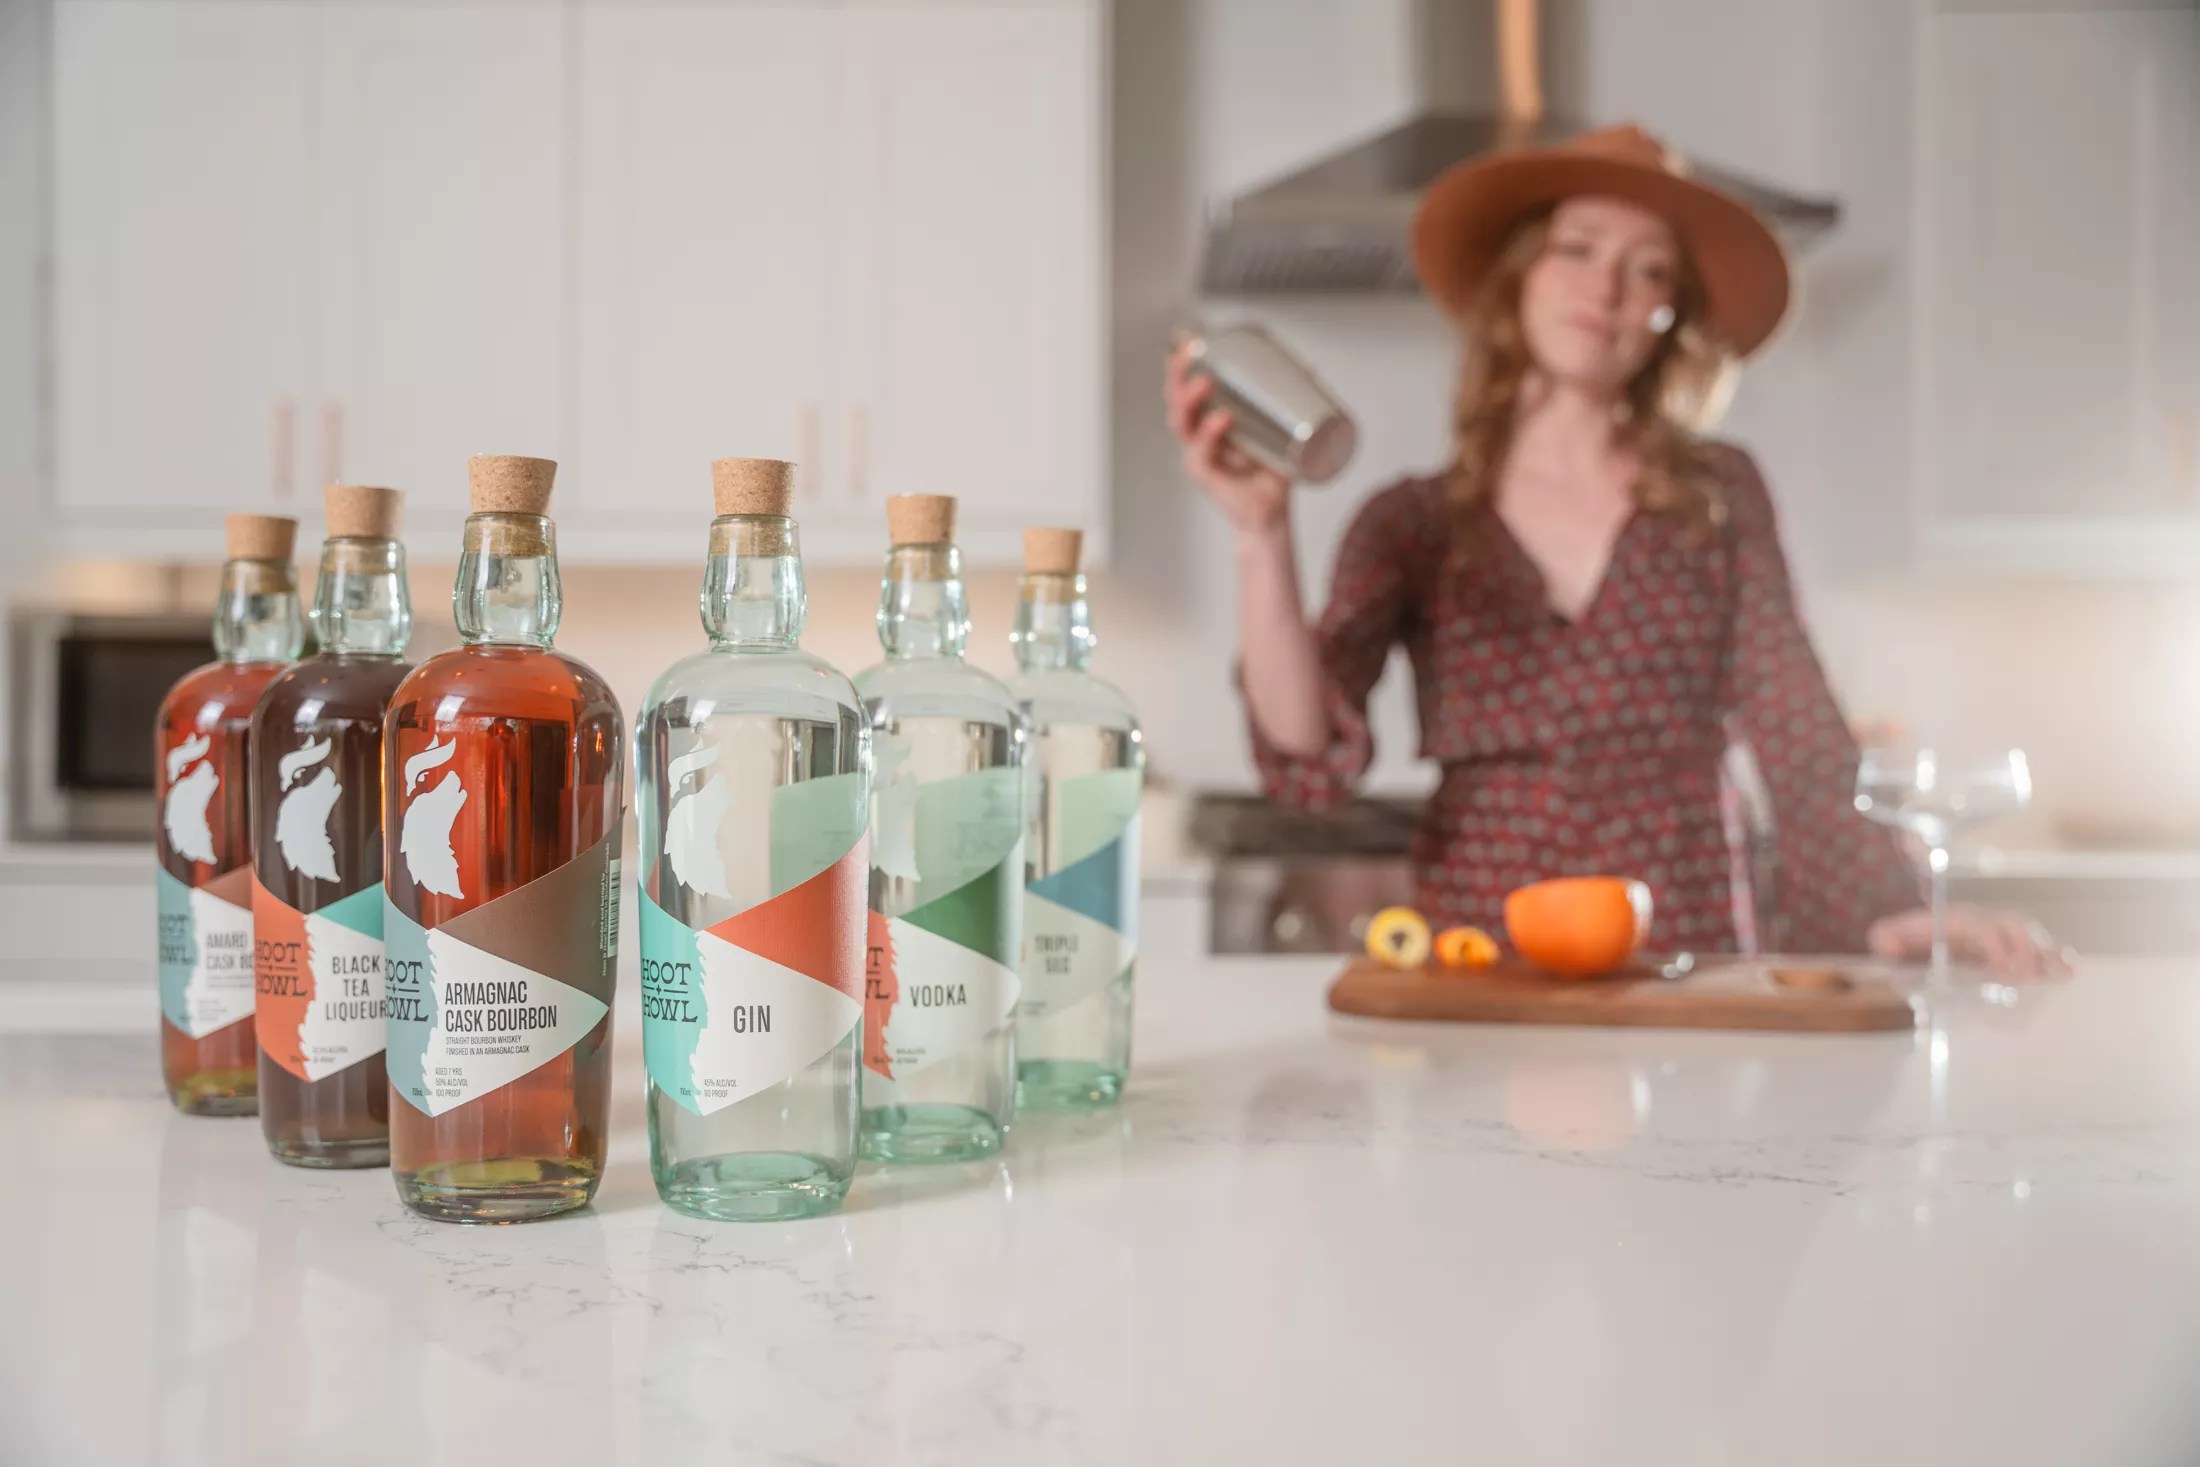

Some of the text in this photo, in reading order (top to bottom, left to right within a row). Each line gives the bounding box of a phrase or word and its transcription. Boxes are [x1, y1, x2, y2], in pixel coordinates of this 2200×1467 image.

[332, 955, 381, 975] BLACK
[642, 959, 692, 985] HOOT
[343, 979, 370, 997] TEA
[444, 981, 528, 1005] ARMAGNAC
[910, 984, 967, 1007] VODKA
[445, 1005, 557, 1032] CASK BOURBON
[643, 995, 698, 1023] HOWL
[733, 1005, 771, 1034] GIN
[446, 1047, 468, 1056] FINISHED
[476, 1047, 484, 1055] AN
[484, 1046, 515, 1055] ARMAGNAC
[515, 1045, 530, 1054] CASK
[471, 1036, 497, 1045] BOURBON
[498, 1035, 522, 1044] WHISKEY
